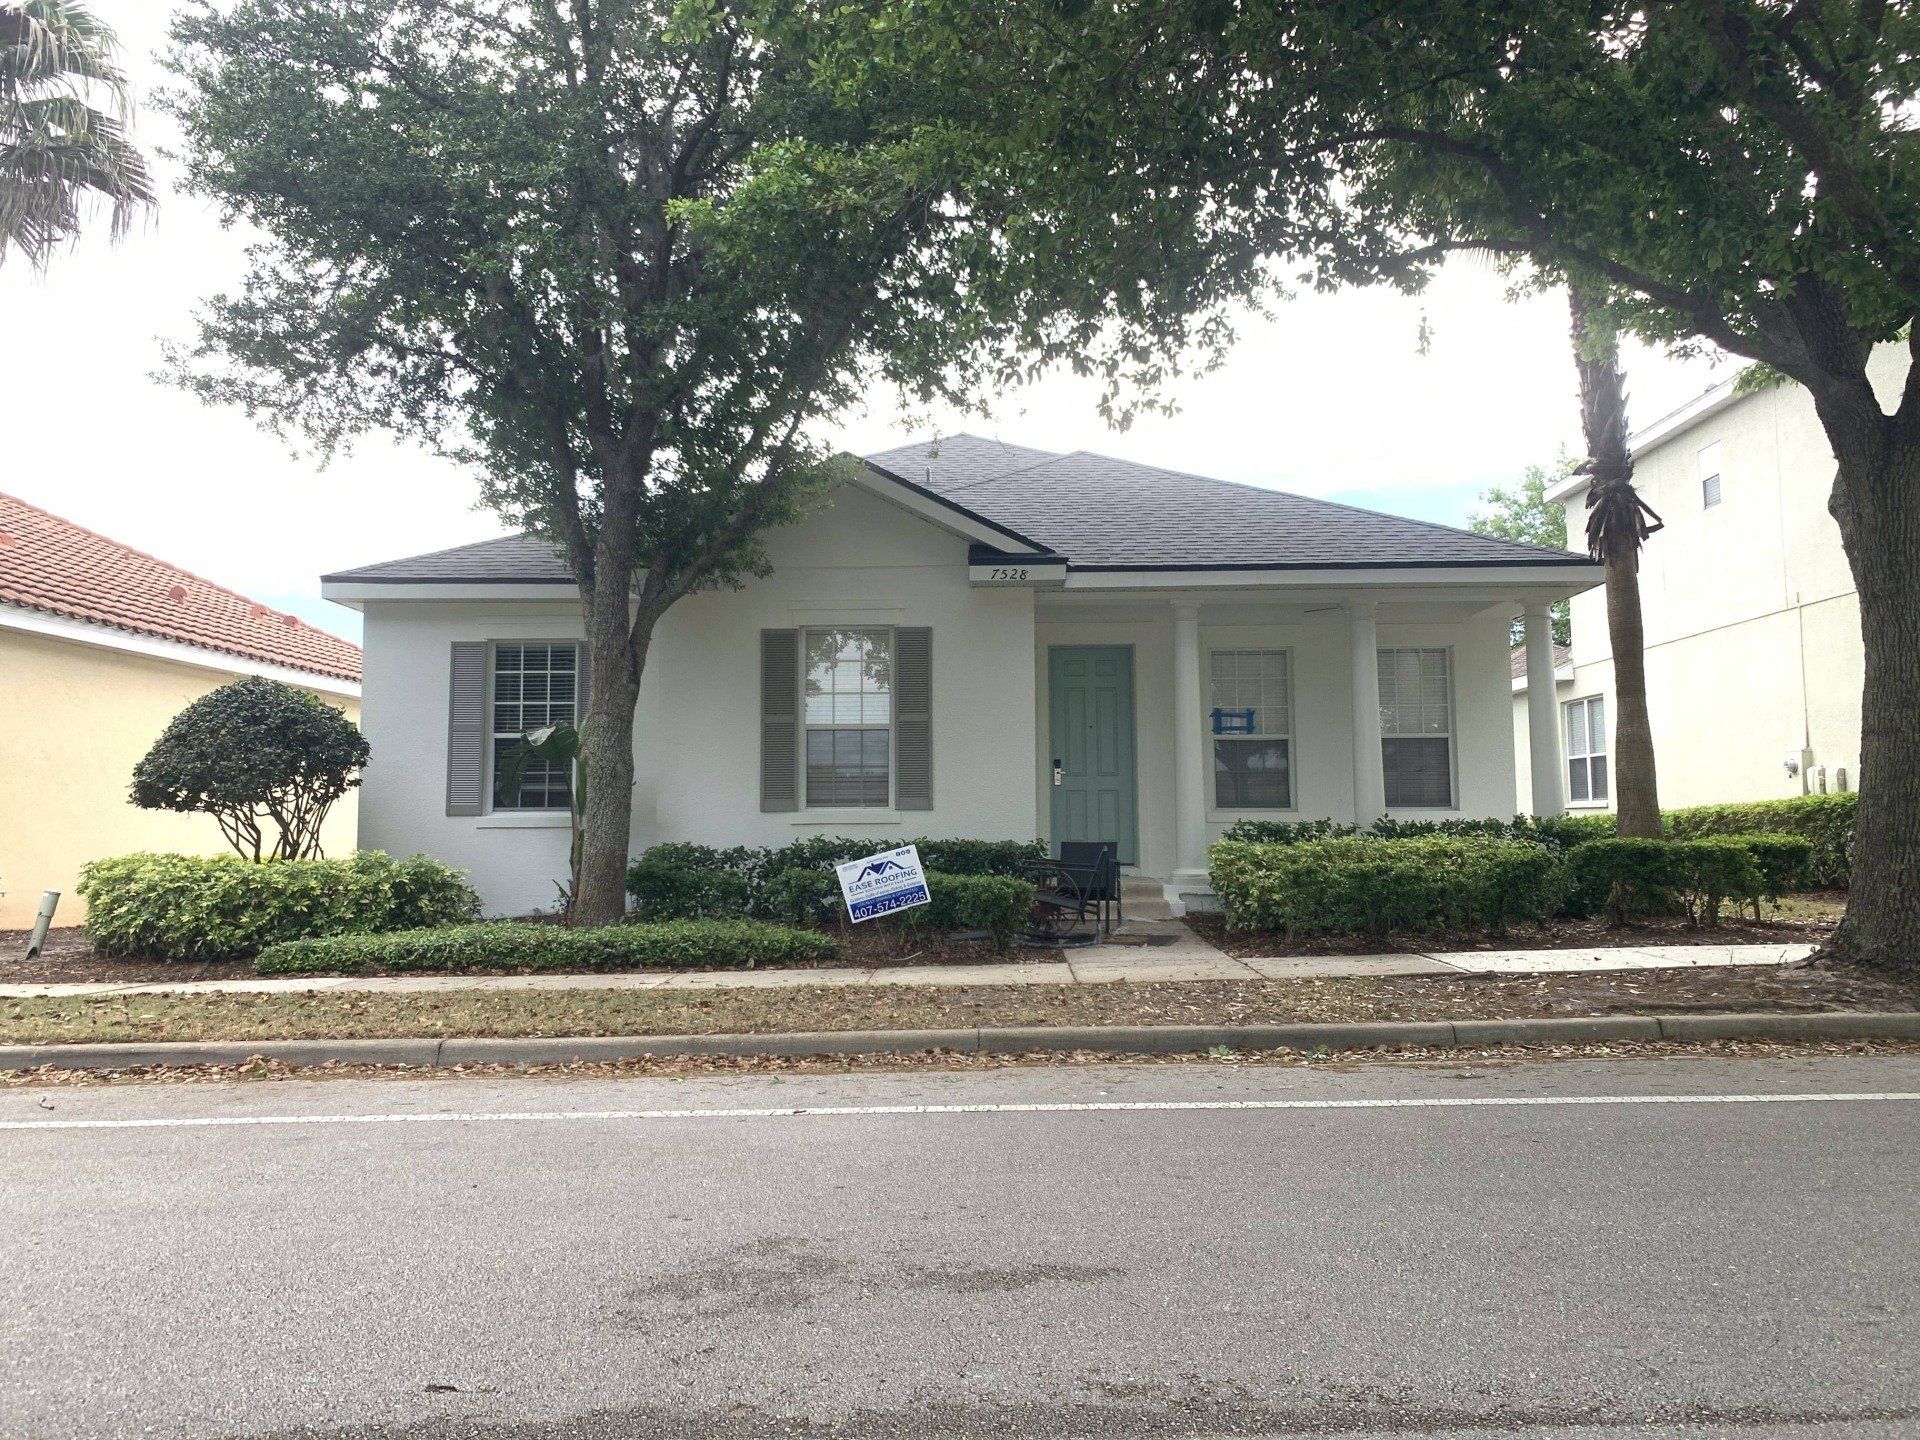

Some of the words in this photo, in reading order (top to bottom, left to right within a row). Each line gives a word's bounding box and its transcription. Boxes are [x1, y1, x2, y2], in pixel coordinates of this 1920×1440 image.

[991, 569, 1028, 580] 7528
[848, 880, 873, 893] EASE
[875, 868, 917, 885] ROOFING
[854, 891, 926, 919] 407-574-2225
